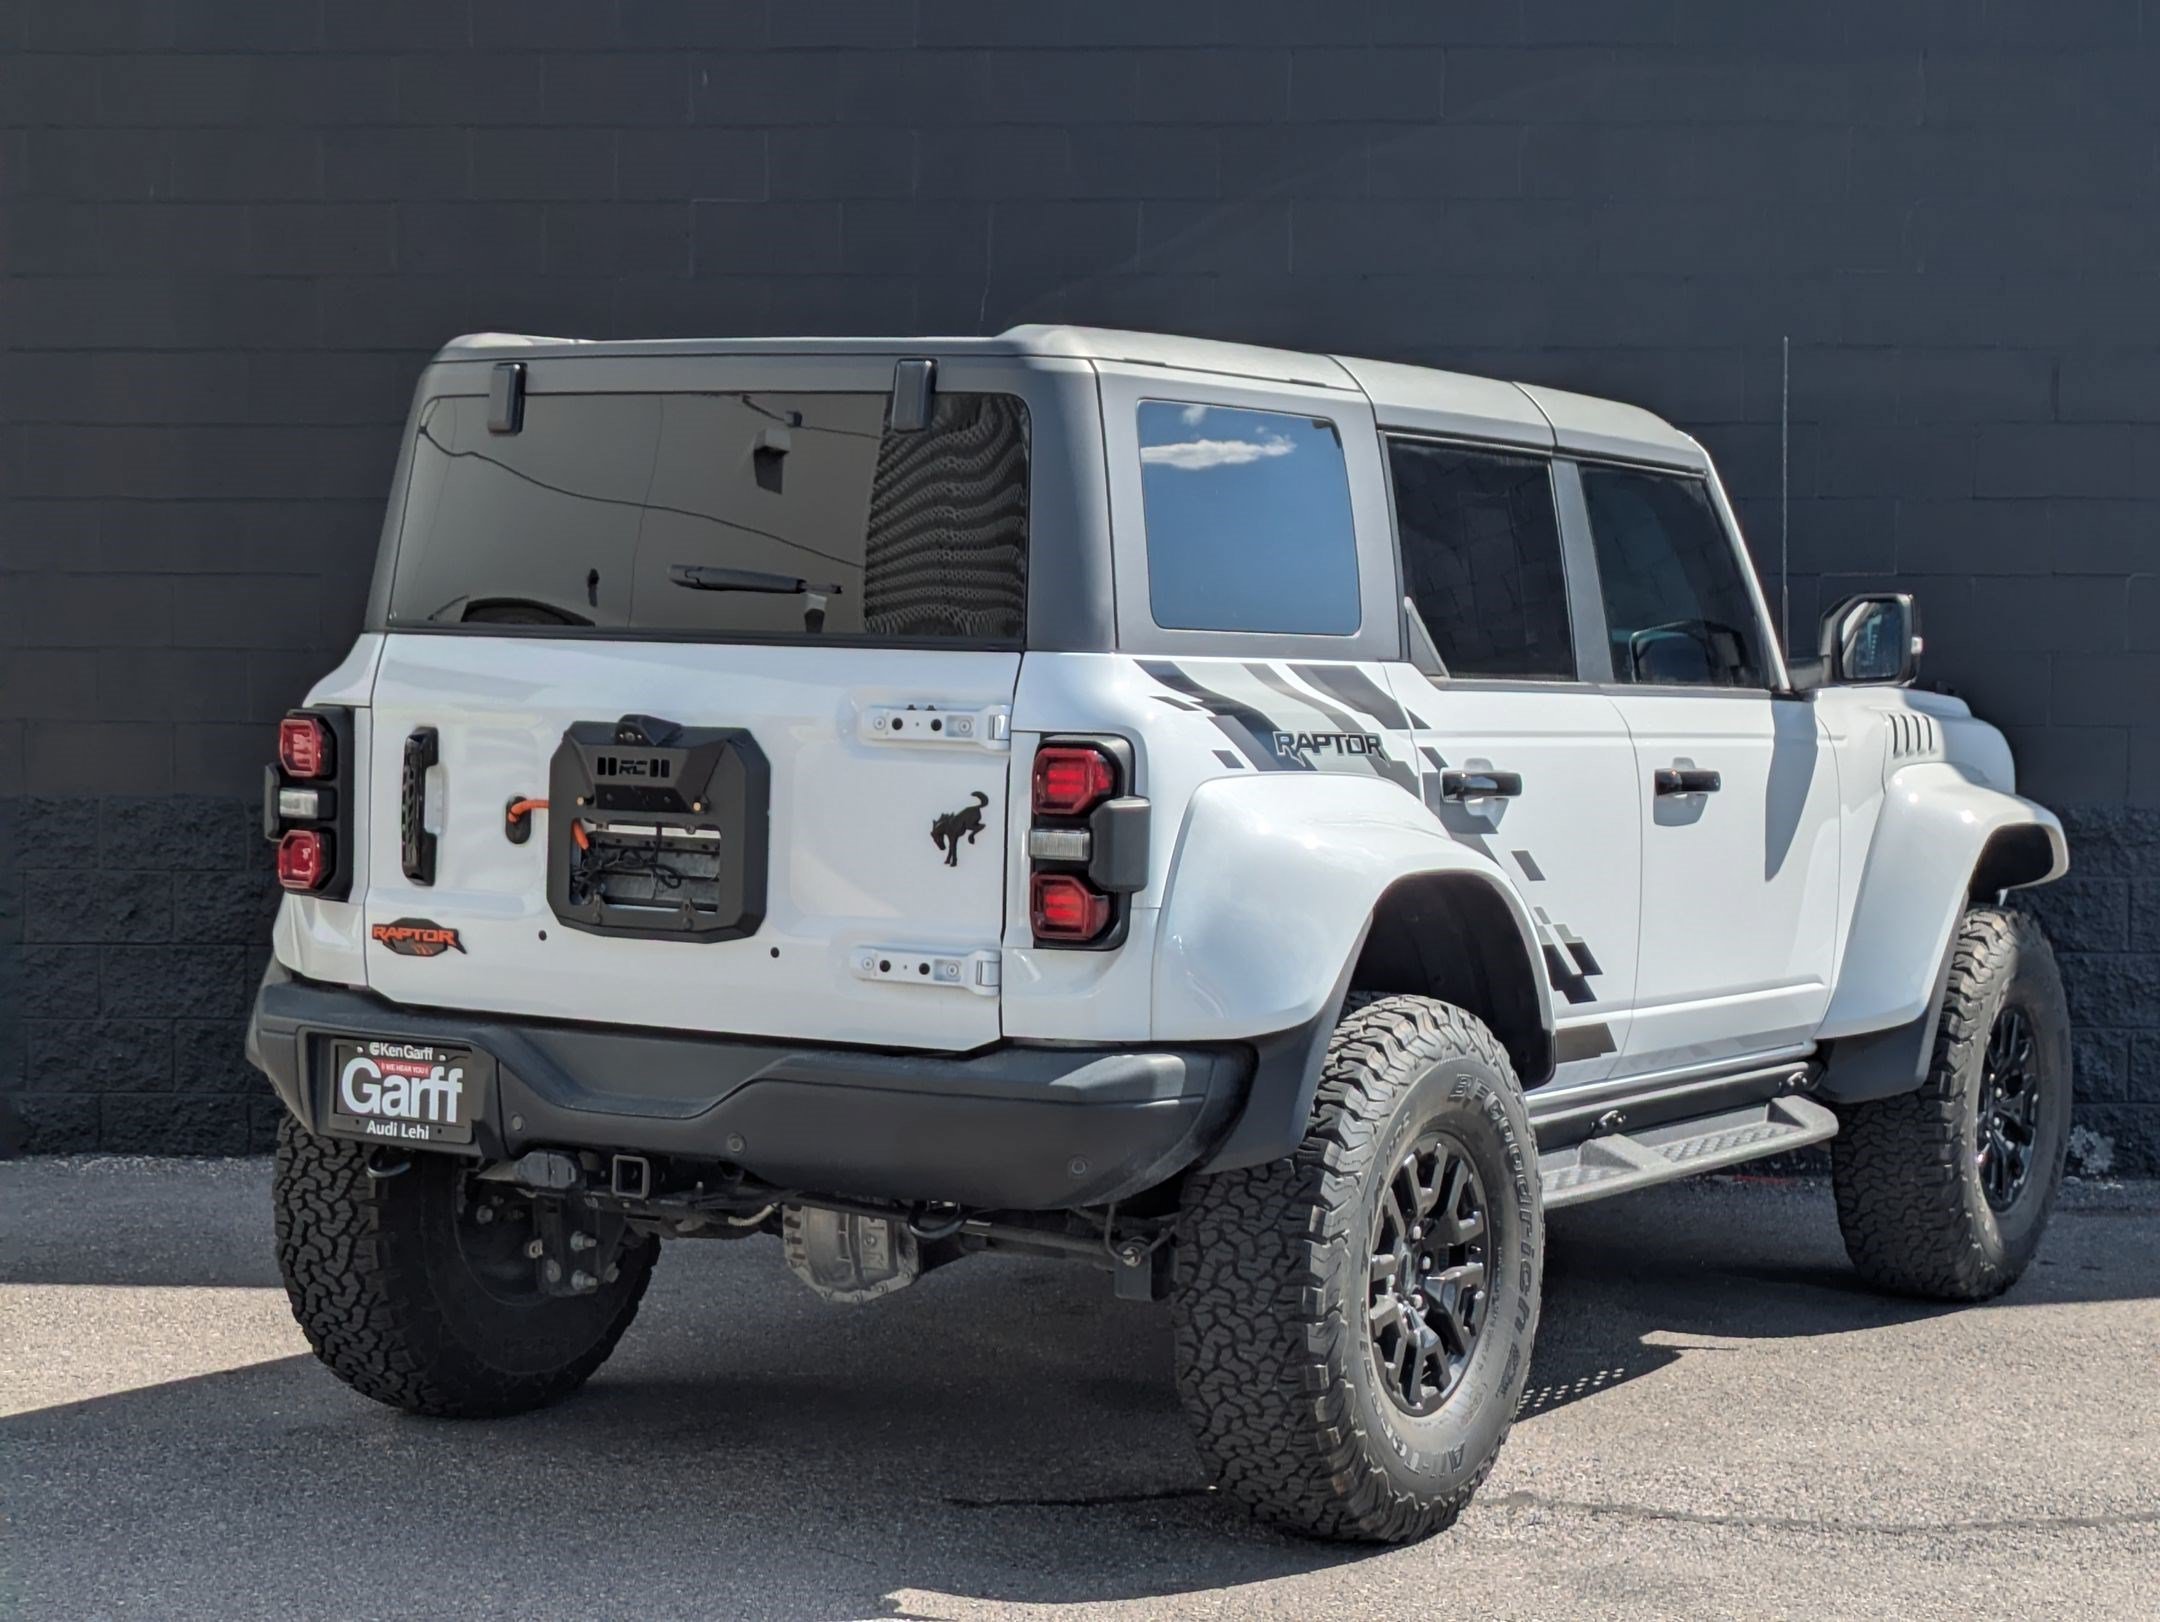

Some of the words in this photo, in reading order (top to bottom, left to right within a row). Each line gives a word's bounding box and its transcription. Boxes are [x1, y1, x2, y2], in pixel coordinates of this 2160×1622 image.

[1272, 730, 1391, 768] RAPTOR
[371, 924, 459, 946] RAPTOR
[341, 1057, 464, 1123] Garff
[366, 1120, 397, 1136] Audi
[401, 1122, 430, 1140] Lehi
